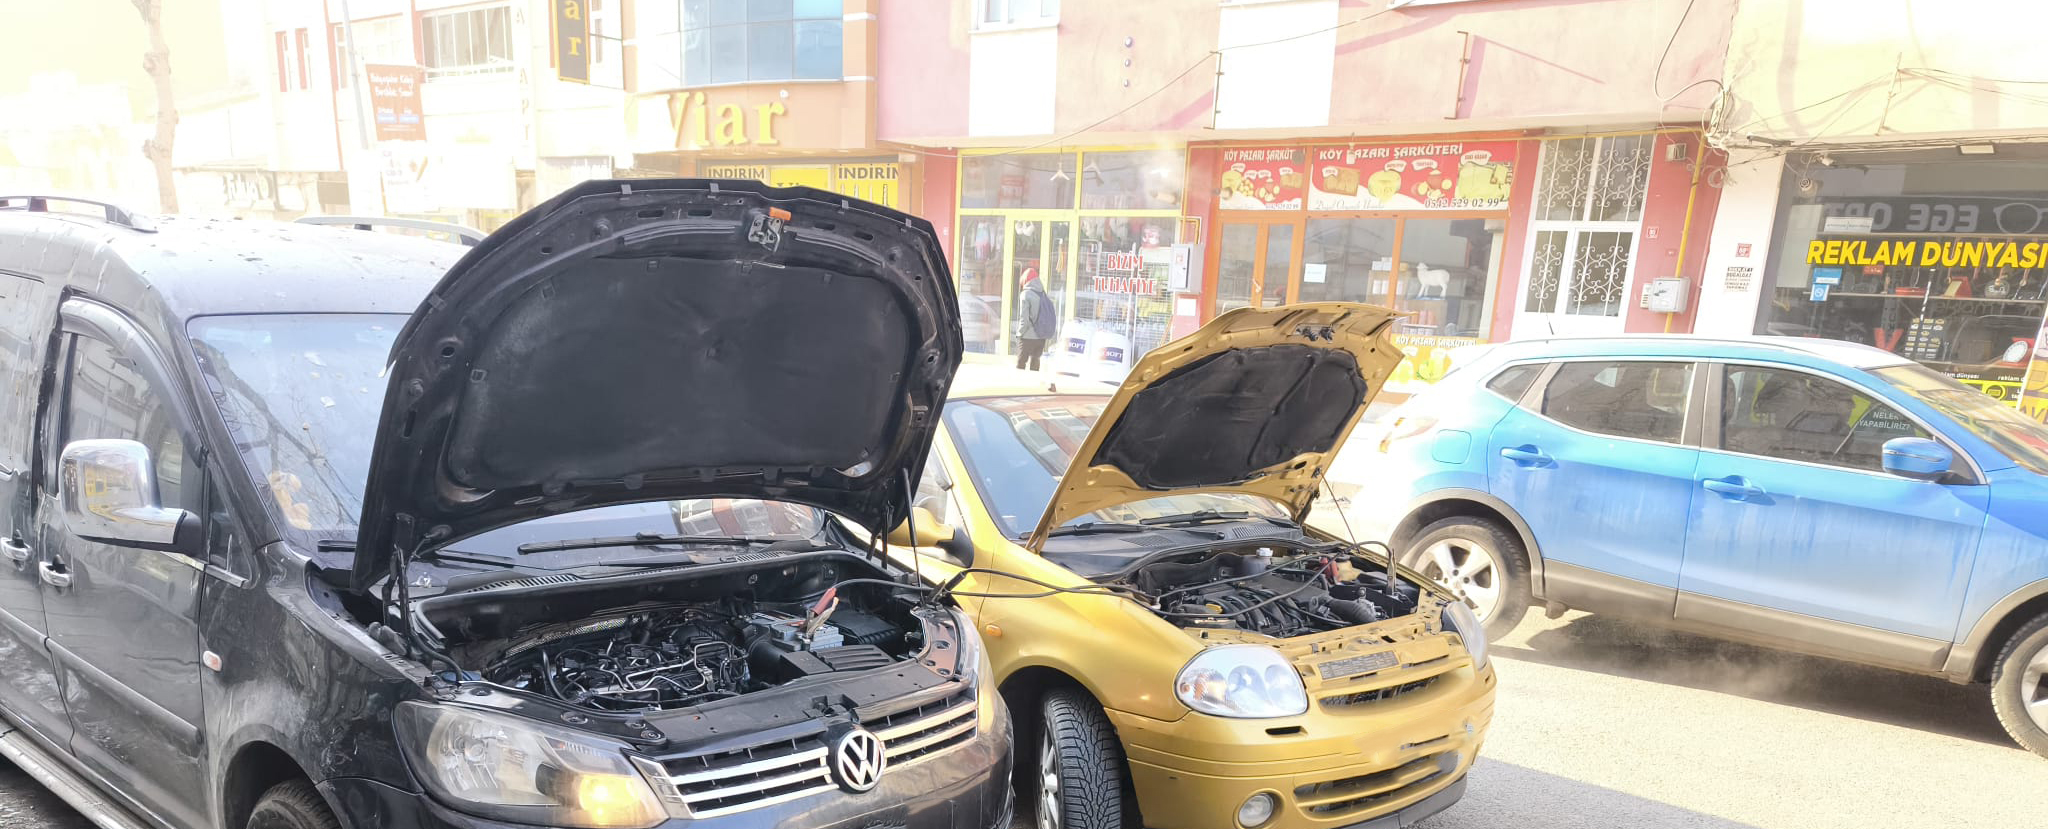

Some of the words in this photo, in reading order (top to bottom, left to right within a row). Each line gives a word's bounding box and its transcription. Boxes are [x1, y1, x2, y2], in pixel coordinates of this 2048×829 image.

[660, 91, 786, 148] Viar
[1319, 149, 1343, 161] KÖY
[1350, 147, 1390, 159] AZARI
[1394, 143, 1463, 160] ŞARKÜTERİ
[1471, 197, 1484, 208] 02
[1107, 250, 1144, 271] BİZİM
[1806, 240, 1917, 266] REKLAM
[1920, 241, 2048, 269] DÜNYASI
[1093, 275, 1157, 295] TUHAFİYE
